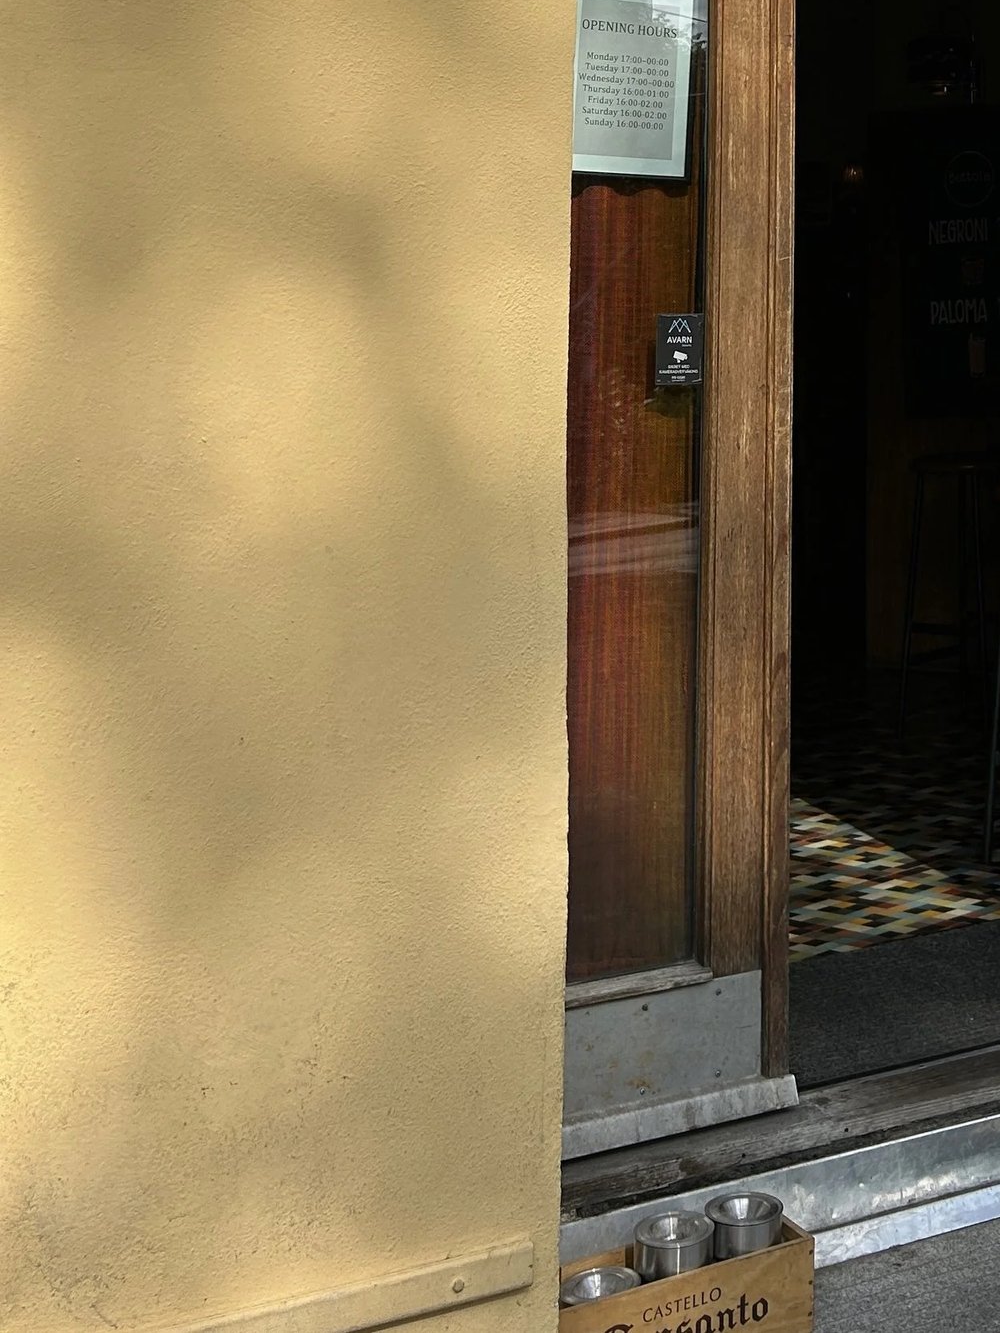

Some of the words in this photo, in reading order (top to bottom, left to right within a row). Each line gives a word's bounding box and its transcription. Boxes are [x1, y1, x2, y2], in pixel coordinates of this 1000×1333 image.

[582, 18, 635, 34] OPENING
[637, 25, 677, 39] HOURS
[586, 52, 619, 63] Monday
[585, 63, 619, 74] Tuesday
[578, 73, 625, 85] Wednesday
[582, 84, 621, 96] Thursday
[588, 95, 614, 107] Friday
[582, 106, 618, 118] Saturday
[585, 117, 615, 128] Sunday
[928, 219, 989, 245] NEGRONI
[930, 299, 988, 325] PALOMA
[643, 1287, 722, 1323] CASTELLO
